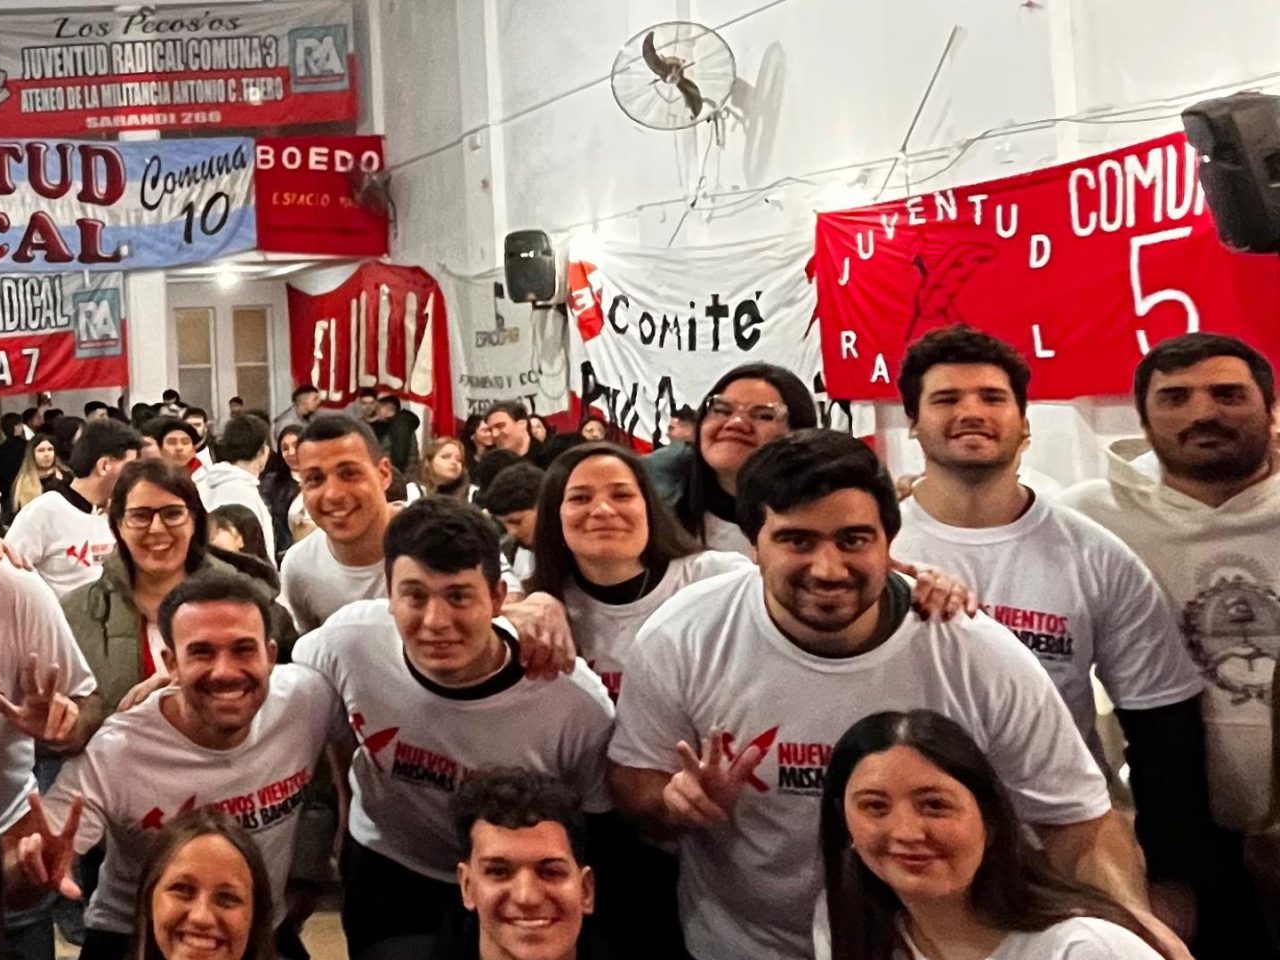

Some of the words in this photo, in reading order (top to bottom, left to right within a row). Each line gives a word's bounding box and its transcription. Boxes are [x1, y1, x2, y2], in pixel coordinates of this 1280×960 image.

[54, 17, 110, 39] Los
[21, 42, 109, 81] JUVENTUD
[111, 37, 186, 76] RADICAL
[187, 35, 263, 72] COMUNA
[264, 34, 279, 69] 3
[295, 35, 345, 77] RA
[21, 87, 65, 114] ATENEO
[66, 86, 84, 110] DE
[84, 84, 100, 109] LA
[100, 79, 171, 108] MILITANCIA
[139, 143, 249, 211] Comuna
[255, 144, 380, 173] BOEDO
[1069, 140, 1206, 237] COMU
[181, 191, 230, 245] 10
[837, 189, 1052, 287] JUVENTUD
[1128, 226, 1201, 357] 5
[77, 300, 119, 342] RA
[21, 347, 41, 386] 7
[994, 604, 1069, 635] VIENTOS
[394, 740, 457, 776] NUEVOS
[777, 742, 833, 766] NUEV
